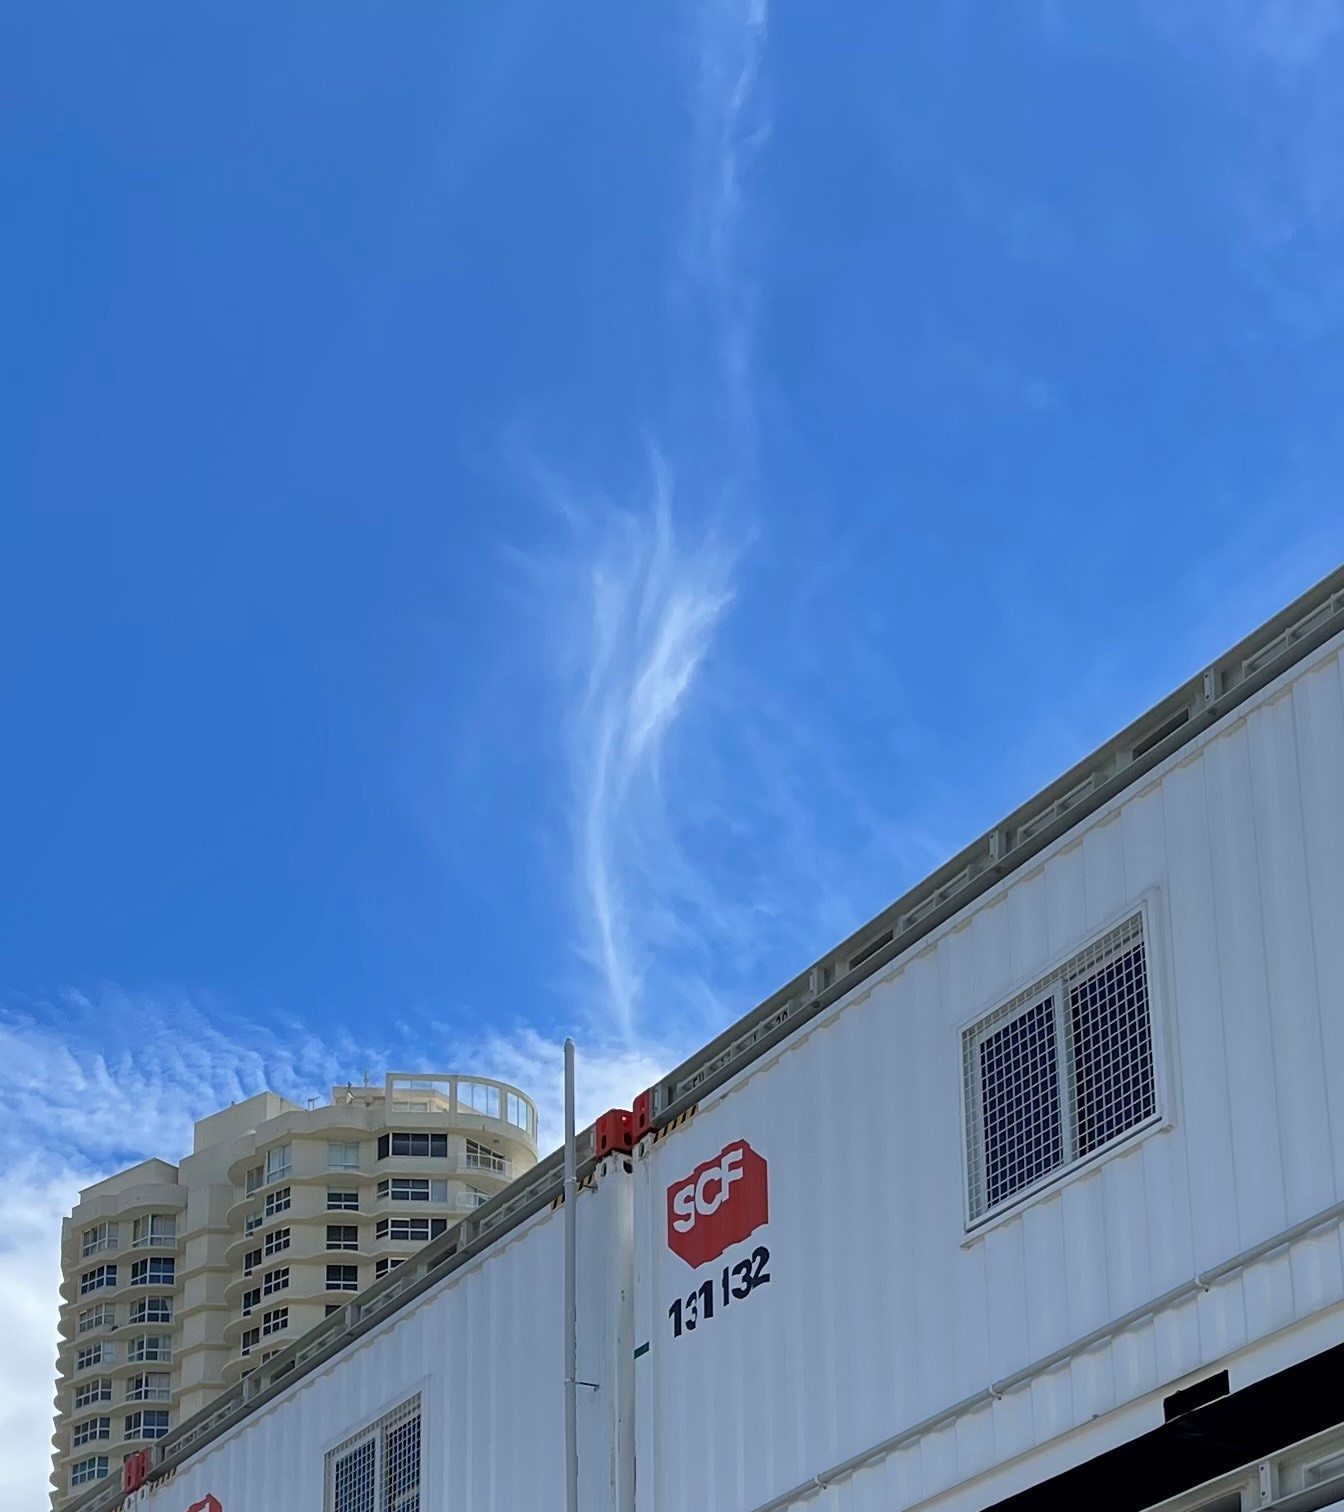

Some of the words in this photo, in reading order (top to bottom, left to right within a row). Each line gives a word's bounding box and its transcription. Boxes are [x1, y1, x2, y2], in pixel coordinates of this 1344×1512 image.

[673, 1149, 744, 1233] SCF
[669, 1281, 714, 1338] 131
[723, 1246, 771, 1306] 132
